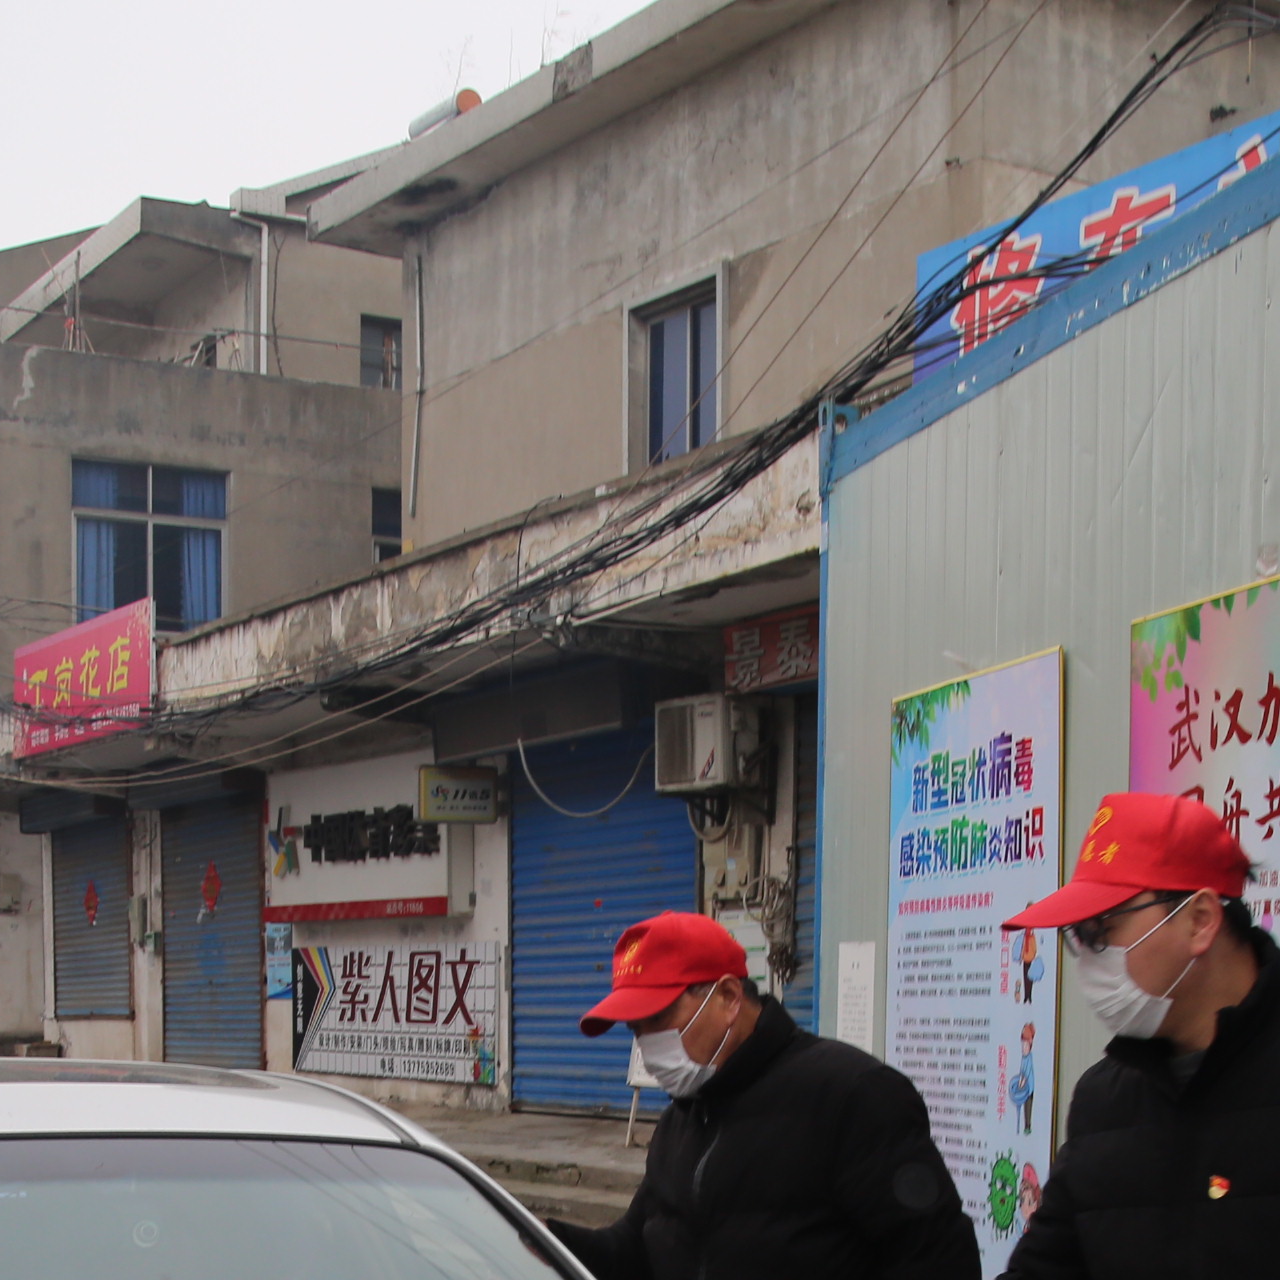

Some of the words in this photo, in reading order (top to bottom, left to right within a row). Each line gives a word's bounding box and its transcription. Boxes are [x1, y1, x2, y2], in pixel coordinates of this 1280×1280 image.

[911, 731, 1034, 813] 新型冠状病毒
[338, 949, 481, 1027] 紫人图文
